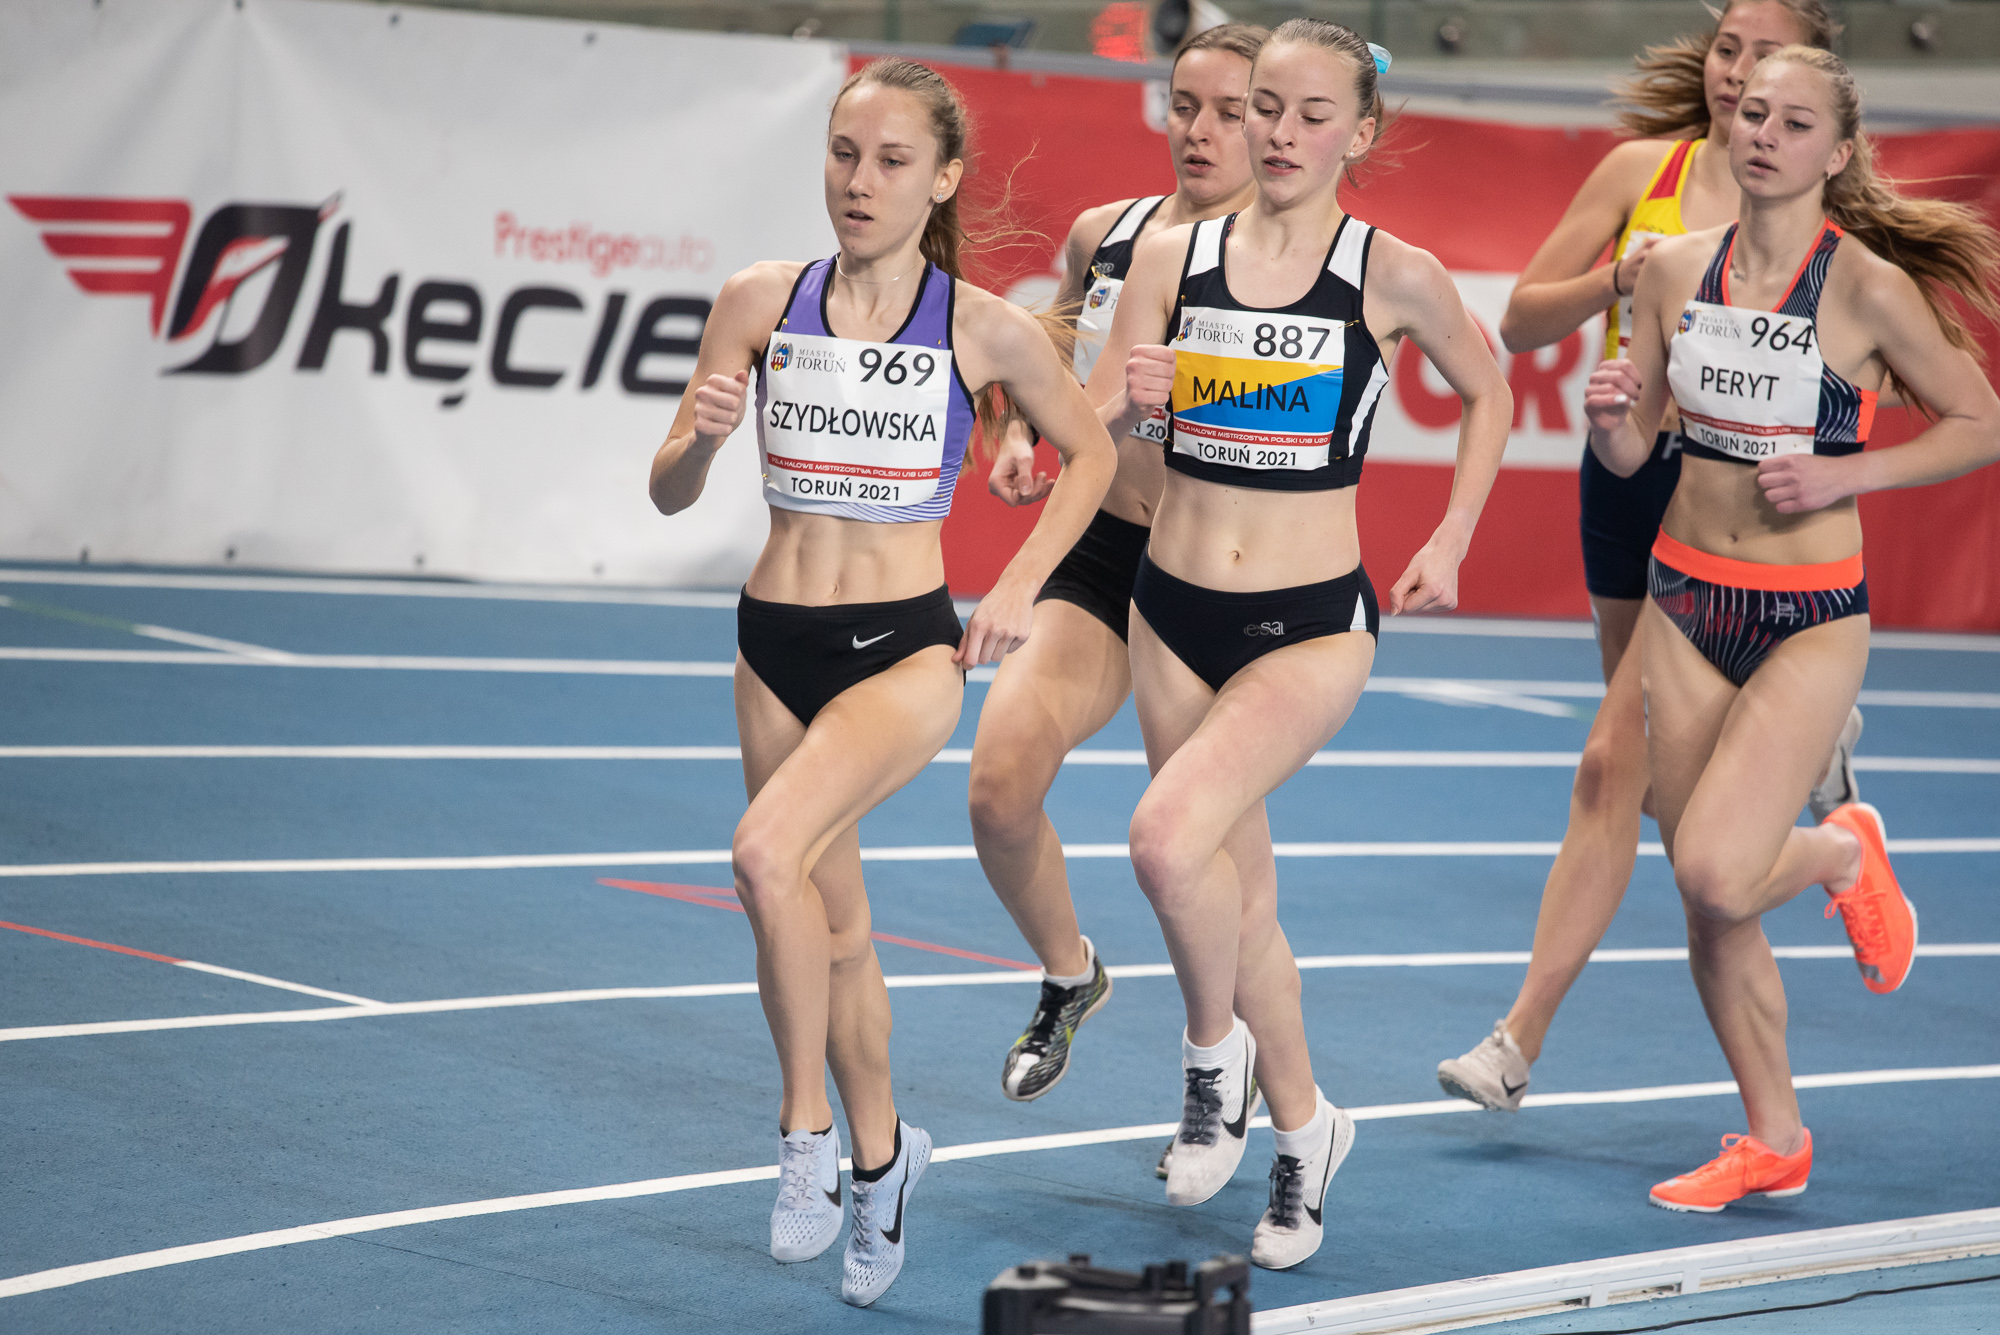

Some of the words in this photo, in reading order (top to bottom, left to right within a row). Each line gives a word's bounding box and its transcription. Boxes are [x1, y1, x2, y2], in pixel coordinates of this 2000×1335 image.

[1196, 327, 1244, 344] TORUŃ
[1198, 320, 1233, 331] MIASTO
[1751, 316, 1815, 355] 964
[799, 348, 836, 358] MIASTO
[1253, 323, 1331, 361] 887
[796, 357, 847, 373] TORUŃ
[859, 348, 935, 386] 969
[1192, 376, 1310, 413] MALINA
[1700, 365, 1780, 402] PERYT
[769, 400, 937, 441] SZYDŁOWSKA
[1197, 442, 1250, 464] TORUŃ
[1256, 450, 1296, 466] 2021
[1700, 428, 1740, 451] TORUŃ
[1743, 439, 1776, 455] 2021
[791, 477, 852, 497] TORUŃ
[857, 483, 900, 501] 2021
